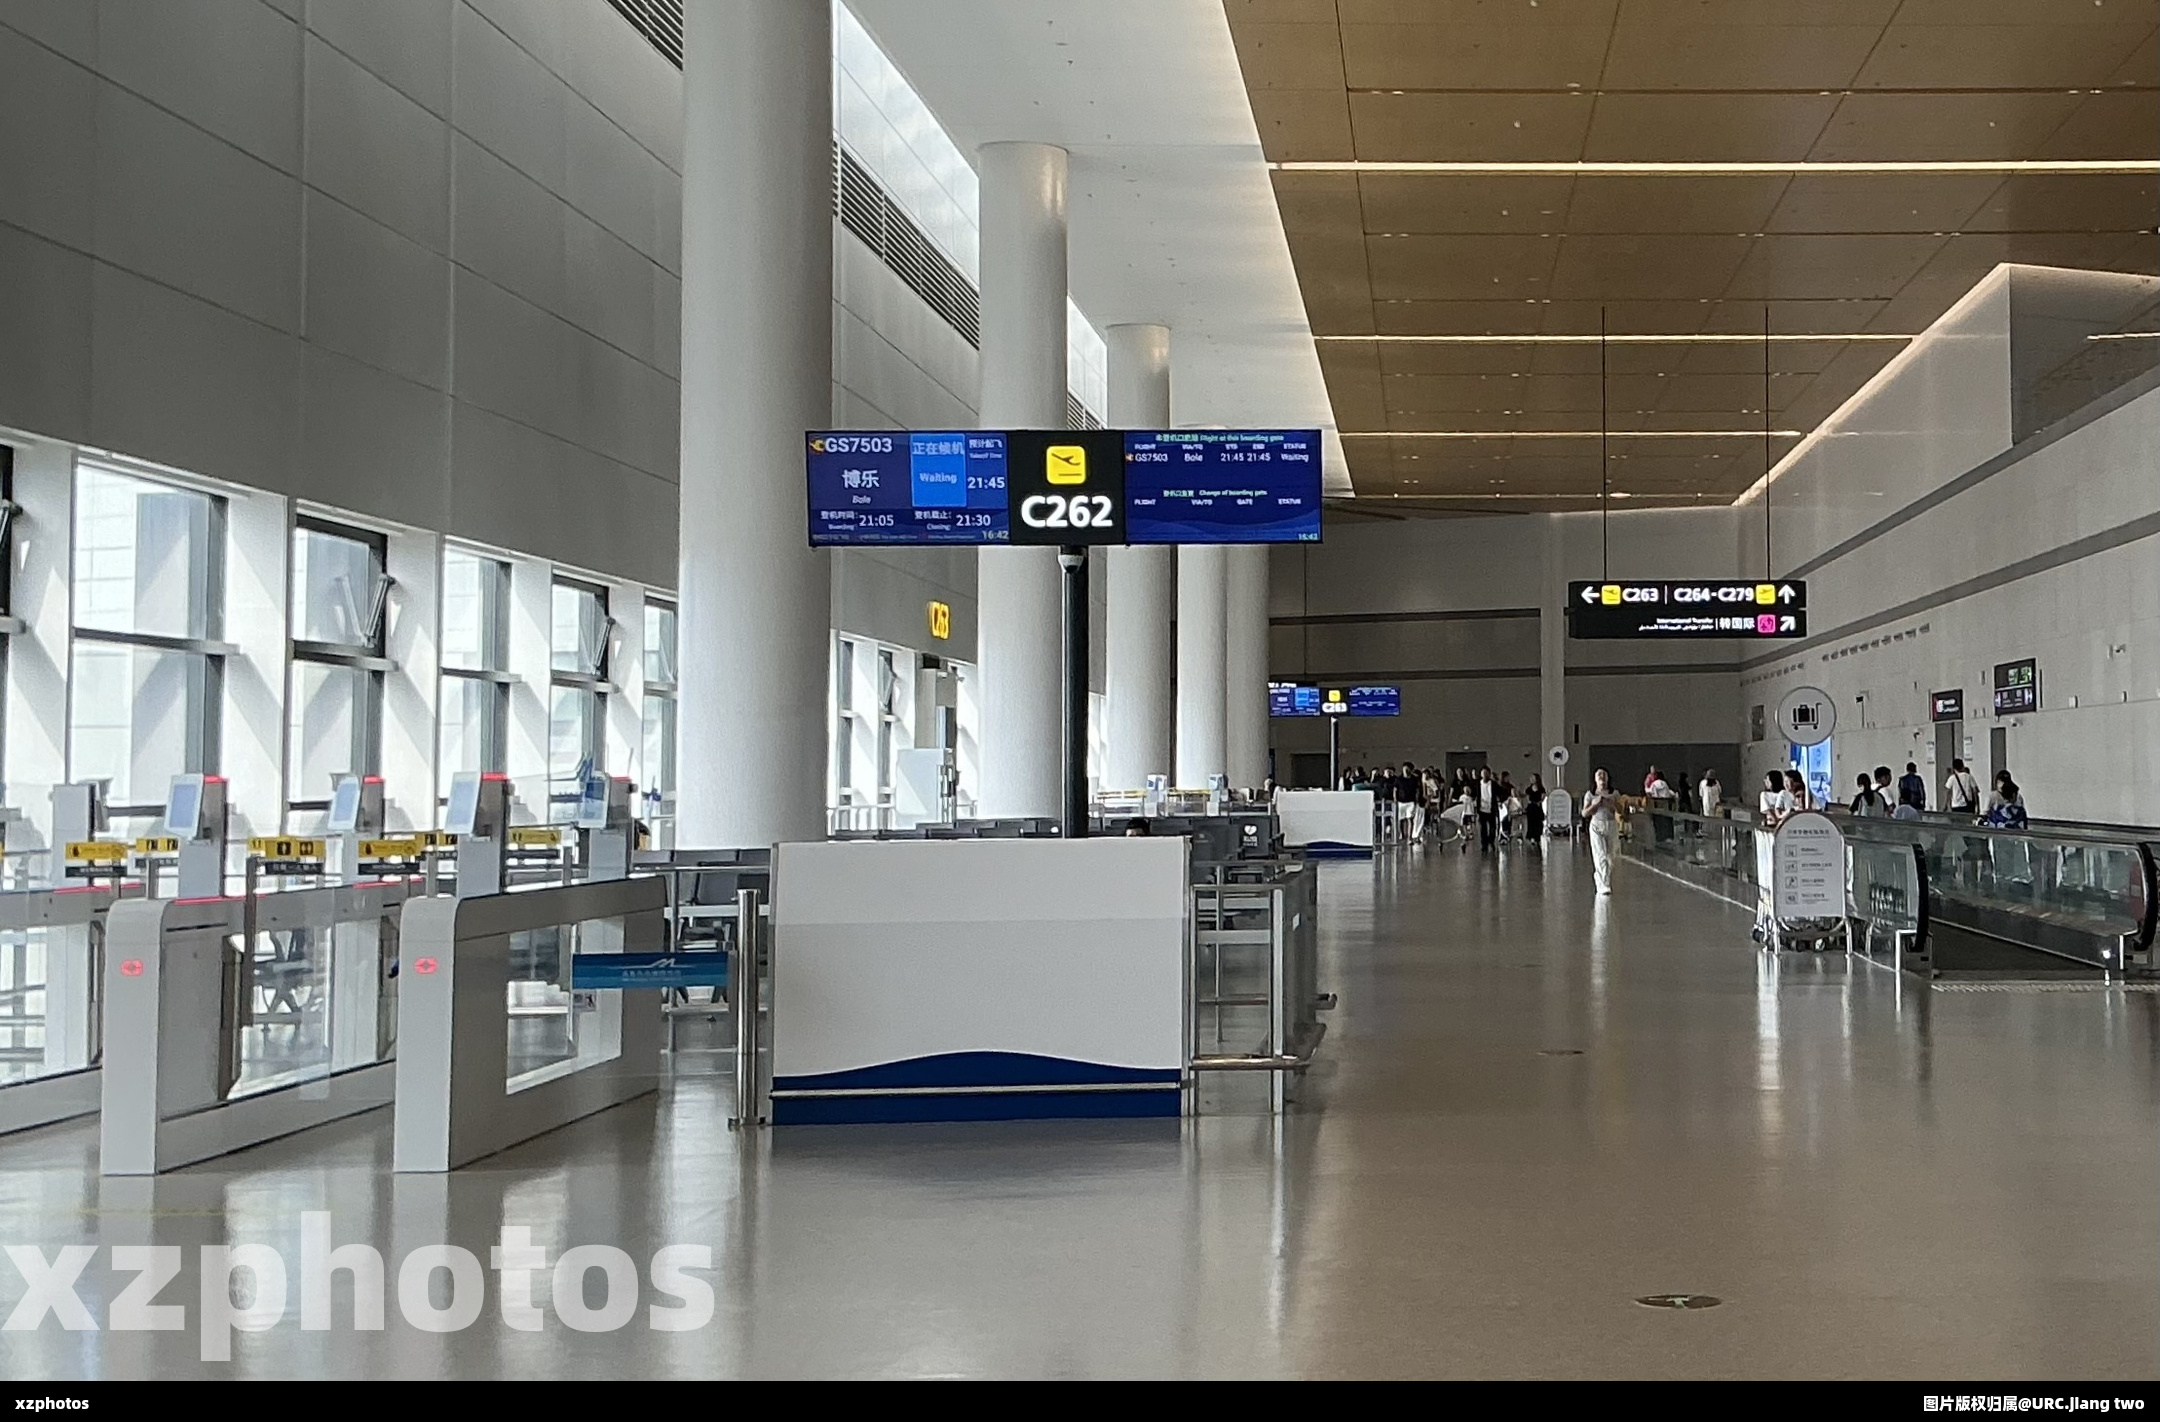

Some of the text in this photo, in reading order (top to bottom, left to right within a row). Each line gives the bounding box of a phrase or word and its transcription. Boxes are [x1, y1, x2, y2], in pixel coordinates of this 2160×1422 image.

[825, 437, 893, 453] GS7503
[1134, 453, 1168, 462] GS7503
[1220, 453, 1244, 462] 21:45
[1247, 453, 1271, 462] 21:45
[1281, 453, 1309, 463] Waiting
[919, 472, 957, 484] Waiting
[967, 477, 1006, 489] 21:45
[1021, 495, 1113, 528] C262
[859, 514, 894, 527] 21:05
[956, 514, 991, 527] 21:30
[1622, 587, 1659, 602] C263
[1673, 587, 1755, 602] C264-C279
